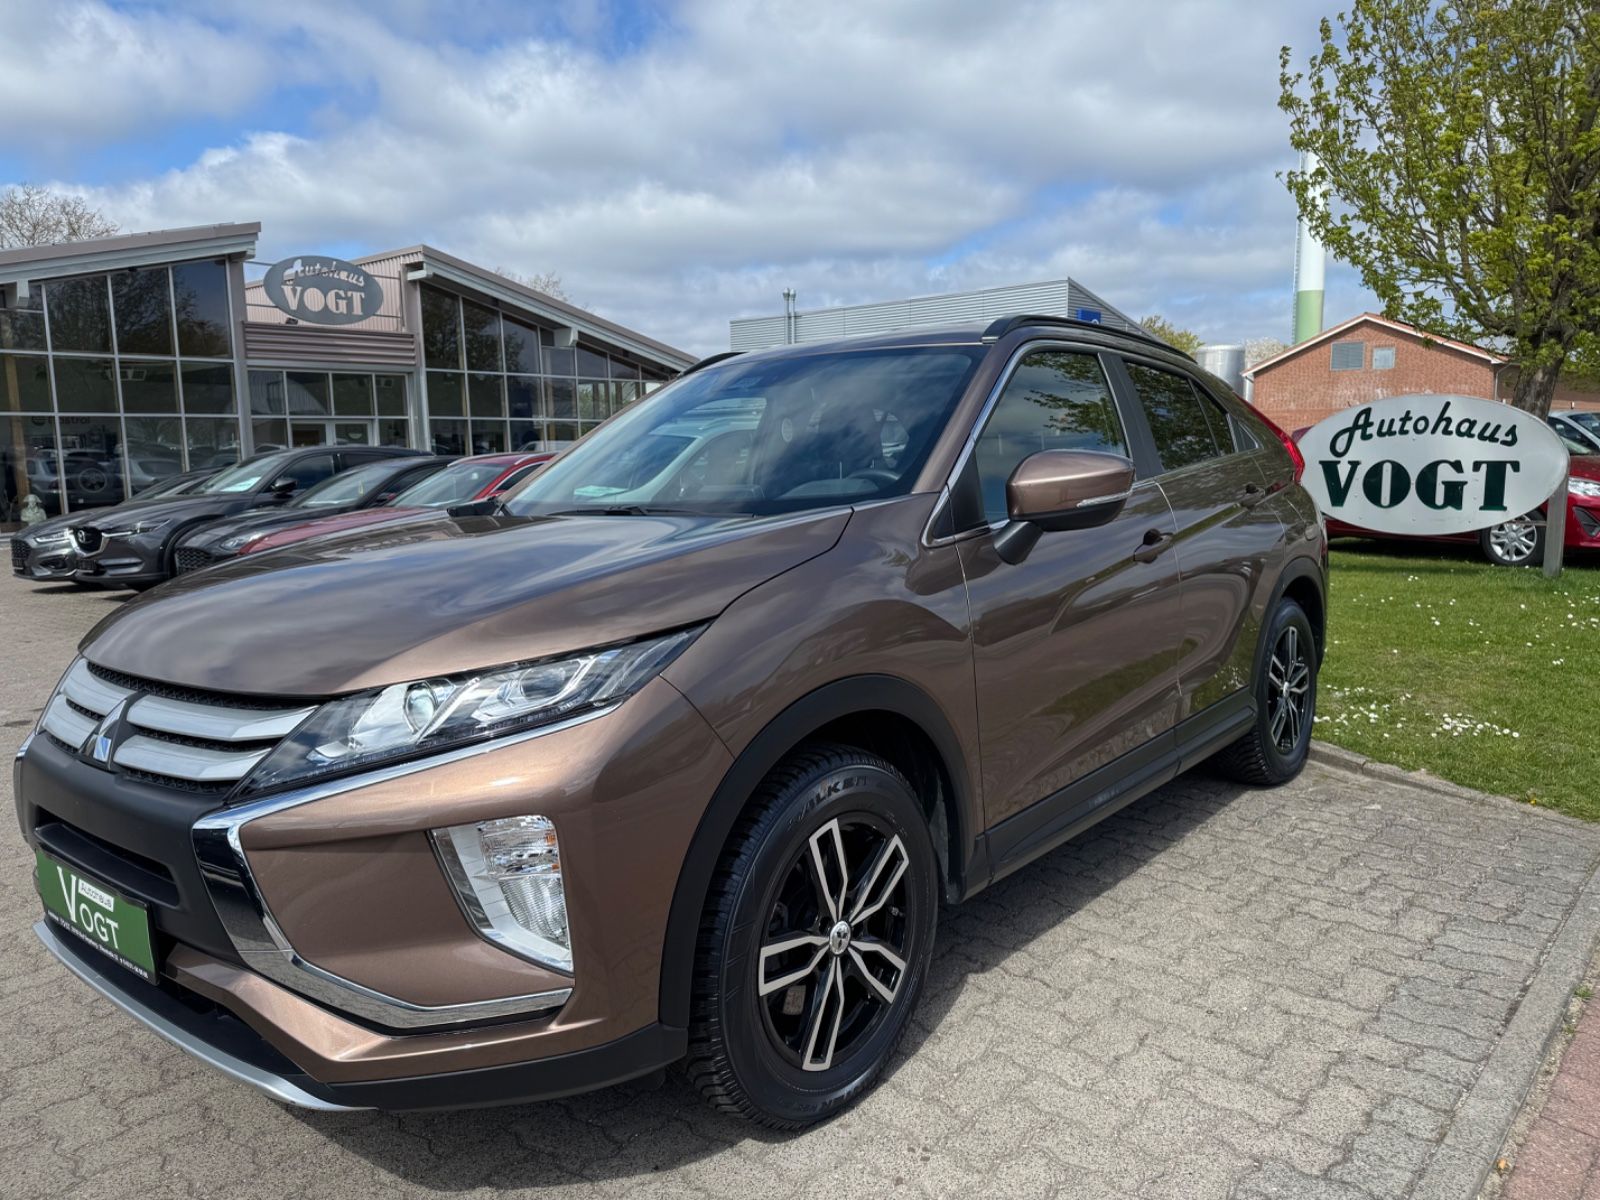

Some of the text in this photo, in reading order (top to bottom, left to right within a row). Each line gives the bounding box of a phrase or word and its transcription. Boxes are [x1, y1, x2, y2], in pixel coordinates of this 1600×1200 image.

[282, 258, 365, 288] Autohaus
[281, 285, 365, 315] VOGT
[1329, 400, 1518, 458] Autohaus
[1319, 459, 1520, 511] VOGT
[57, 866, 119, 950] VOGT
